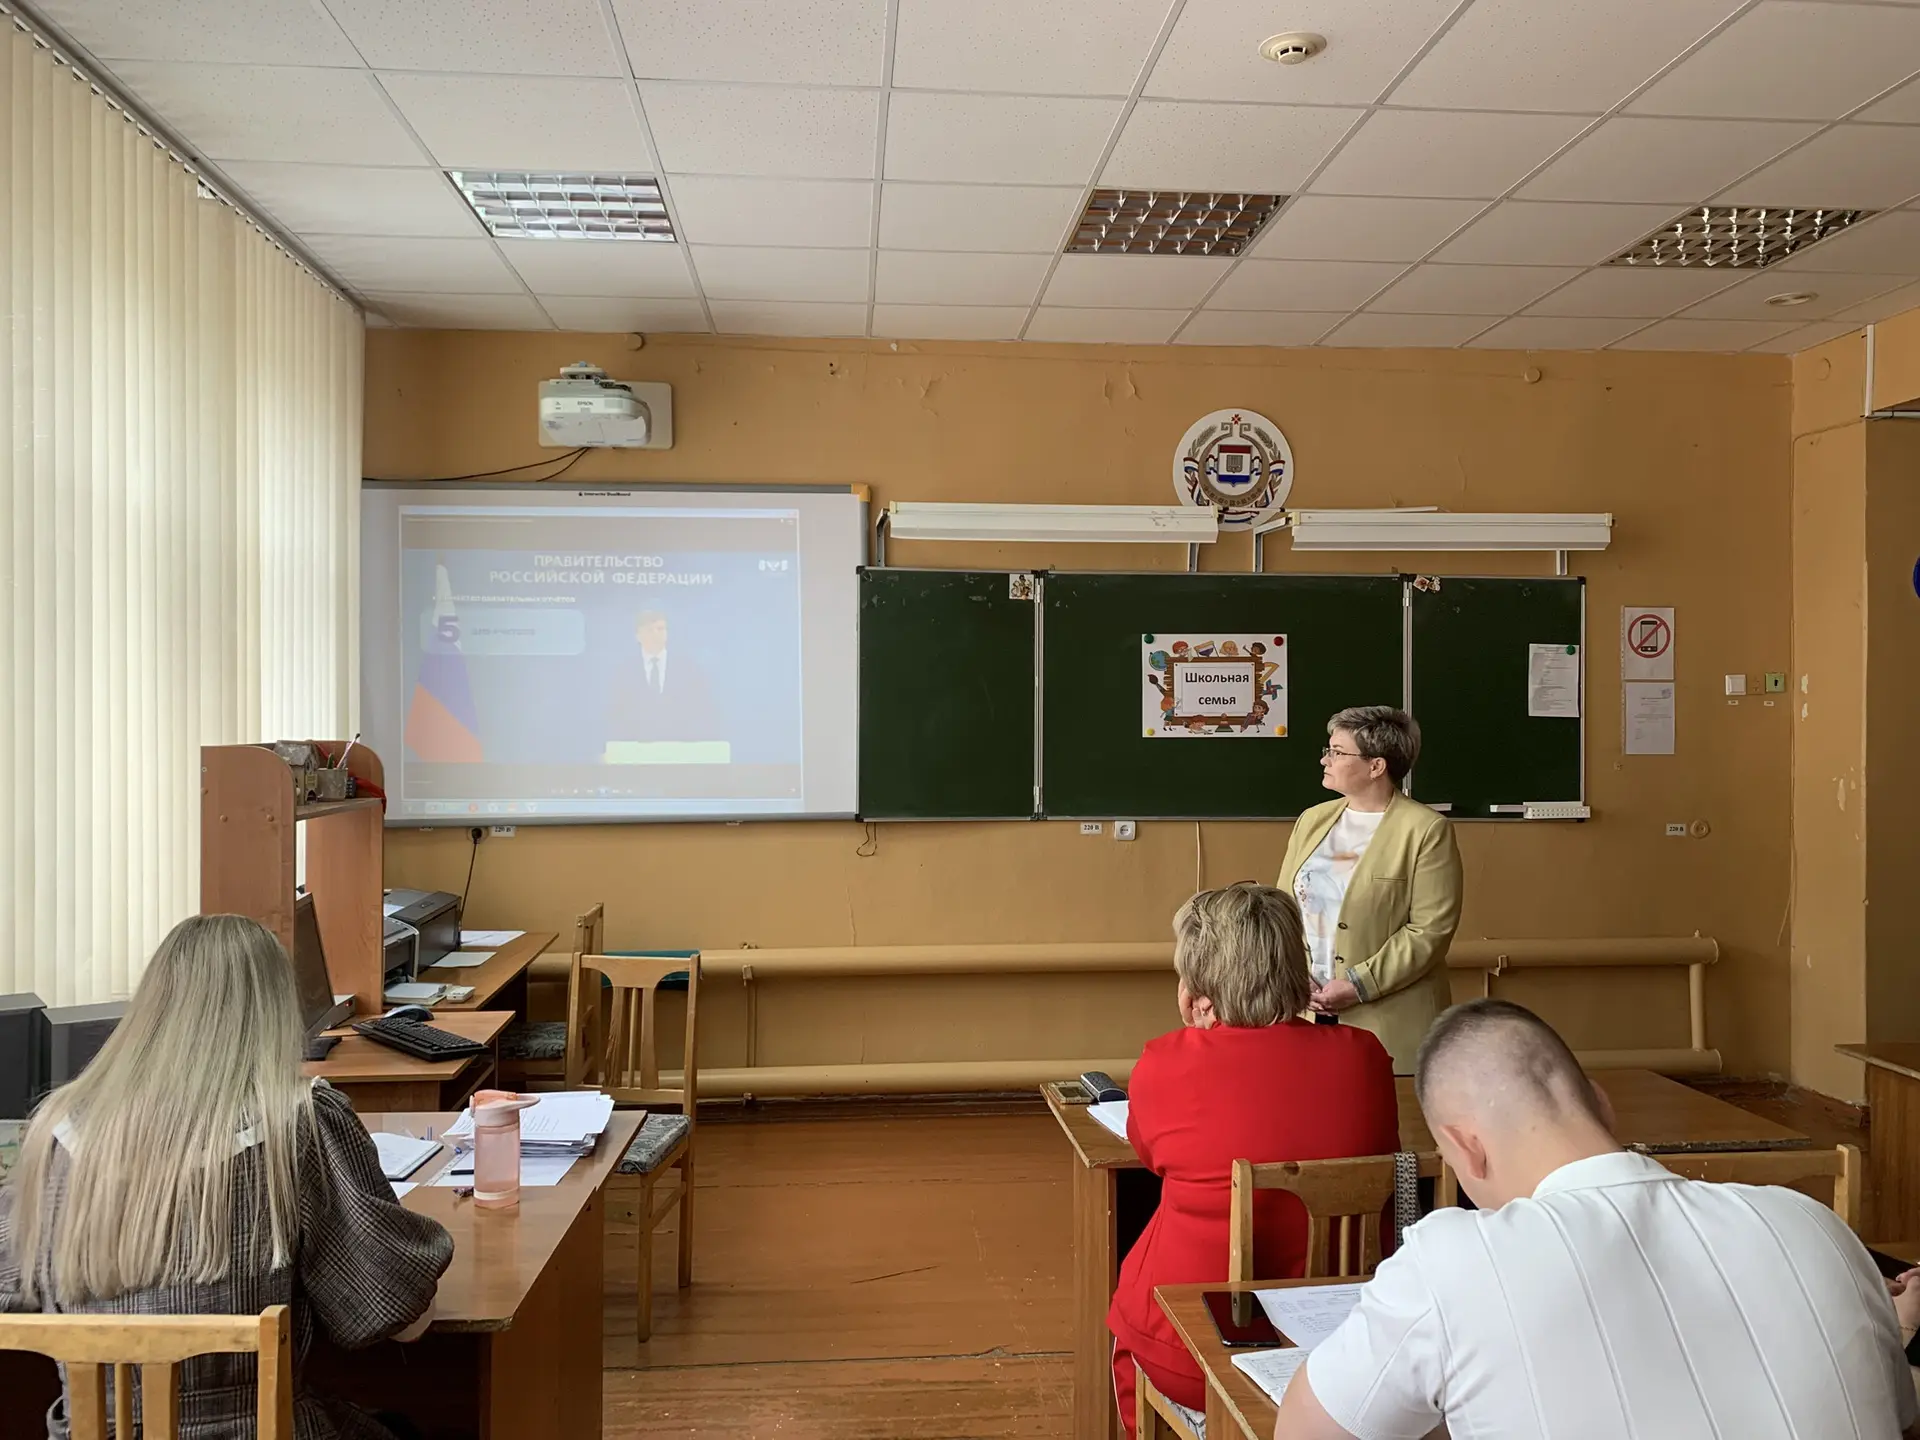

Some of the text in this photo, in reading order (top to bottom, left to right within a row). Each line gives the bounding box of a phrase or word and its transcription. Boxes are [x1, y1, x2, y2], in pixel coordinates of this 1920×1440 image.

[534, 556, 664, 568] ПРАВИТЕЛЬСТВО
[489, 570, 713, 586] РОССИЙСКОЙ ФЕДЕРАЦИИ
[438, 615, 460, 643] 5
[1185, 673, 1249, 683] Школьная
[1198, 696, 1236, 705] семья
